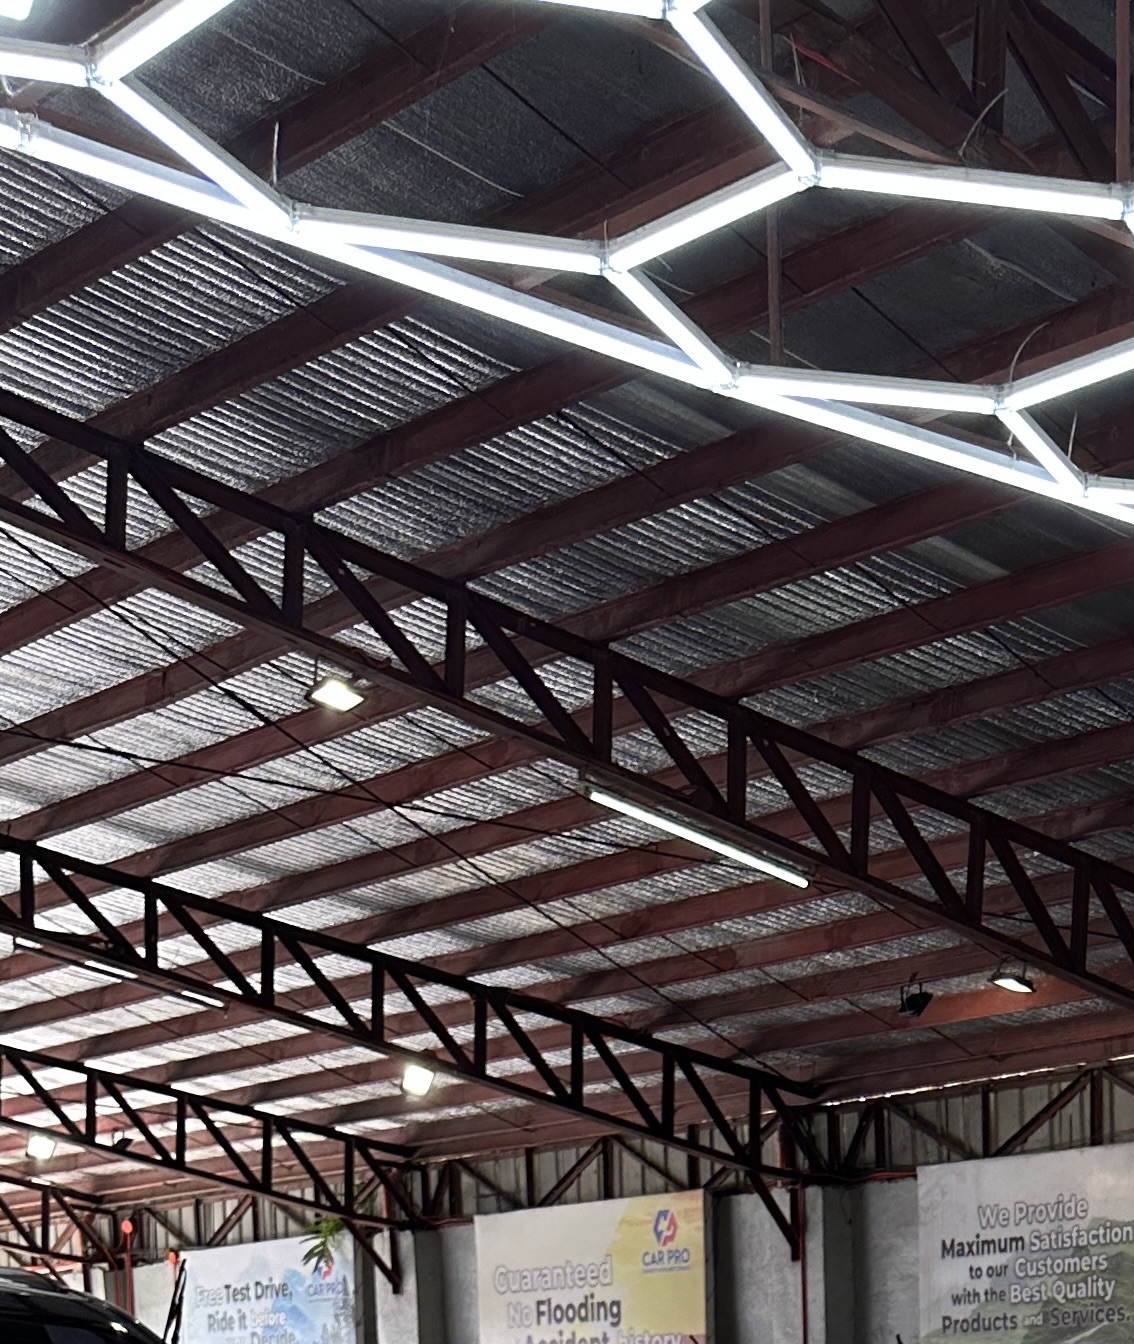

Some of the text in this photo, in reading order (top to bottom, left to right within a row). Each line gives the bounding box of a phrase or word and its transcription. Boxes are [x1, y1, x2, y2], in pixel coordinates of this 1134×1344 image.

[978, 1194, 1088, 1229] We Provide
[941, 1222, 1133, 1259] Maximum Satisfaction
[642, 1249, 690, 1267] CAR PRO
[969, 1253, 1108, 1279] to our Customers
[495, 1254, 613, 1295] Guaranteed
[224, 1281, 250, 1304] Test
[254, 1277, 293, 1301] Drive,
[951, 1277, 1116, 1306] with the Best Quality
[207, 1310, 235, 1332] Ride
[237, 1308, 248, 1330] it
[507, 1294, 622, 1328] No Flooding
[941, 1303, 1131, 1334] Products and Services.
